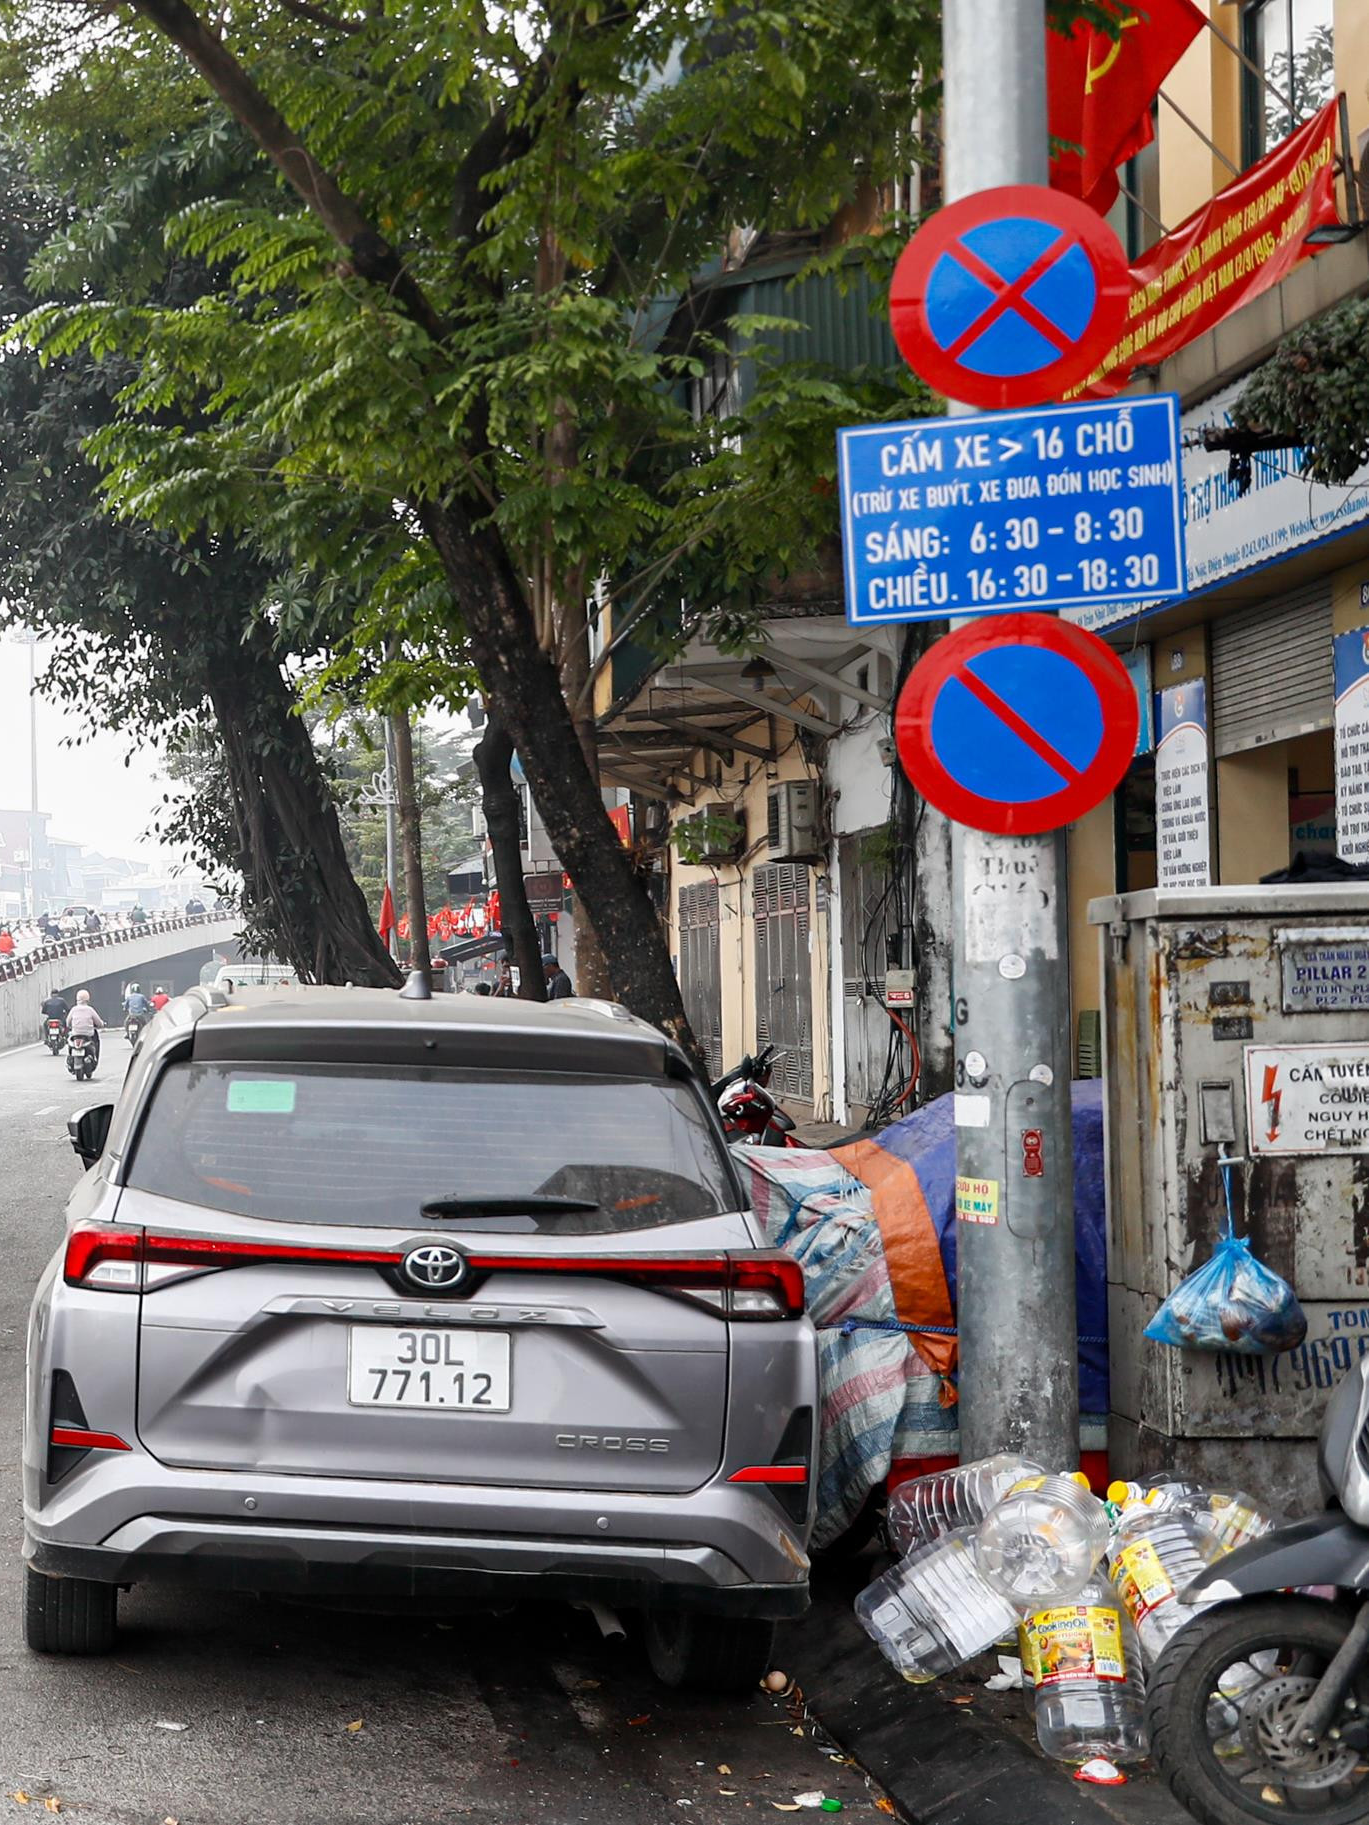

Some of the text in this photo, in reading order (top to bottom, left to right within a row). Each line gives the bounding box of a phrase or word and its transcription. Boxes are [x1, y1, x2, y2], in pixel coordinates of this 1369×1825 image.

[881, 431, 943, 478] CẤM
[955, 434, 992, 470] XE
[1032, 425, 1064, 461] 16
[1075, 406, 1134, 457] CHỖ
[853, 484, 893, 518] (TRỪ
[898, 487, 920, 511] XE
[979, 480, 1002, 503] XE
[1006, 474, 1042, 501] ĐƯA
[1046, 466, 1081, 495] ĐÓN
[1087, 467, 1122, 496] HỌC
[1127, 459, 1174, 488] SINH)
[865, 520, 950, 564] SÁNG:
[1296, 964, 1367, 982] PILLAR 2
[1308, 1111, 1353, 1122] NGUY
[1304, 1124, 1346, 1141] CHẾT
[321, 1300, 548, 1323] VELOZ
[397, 1332, 465, 1367] 30L
[368, 1368, 493, 1406] 771.12
[555, 1434, 671, 1453] CROSS
